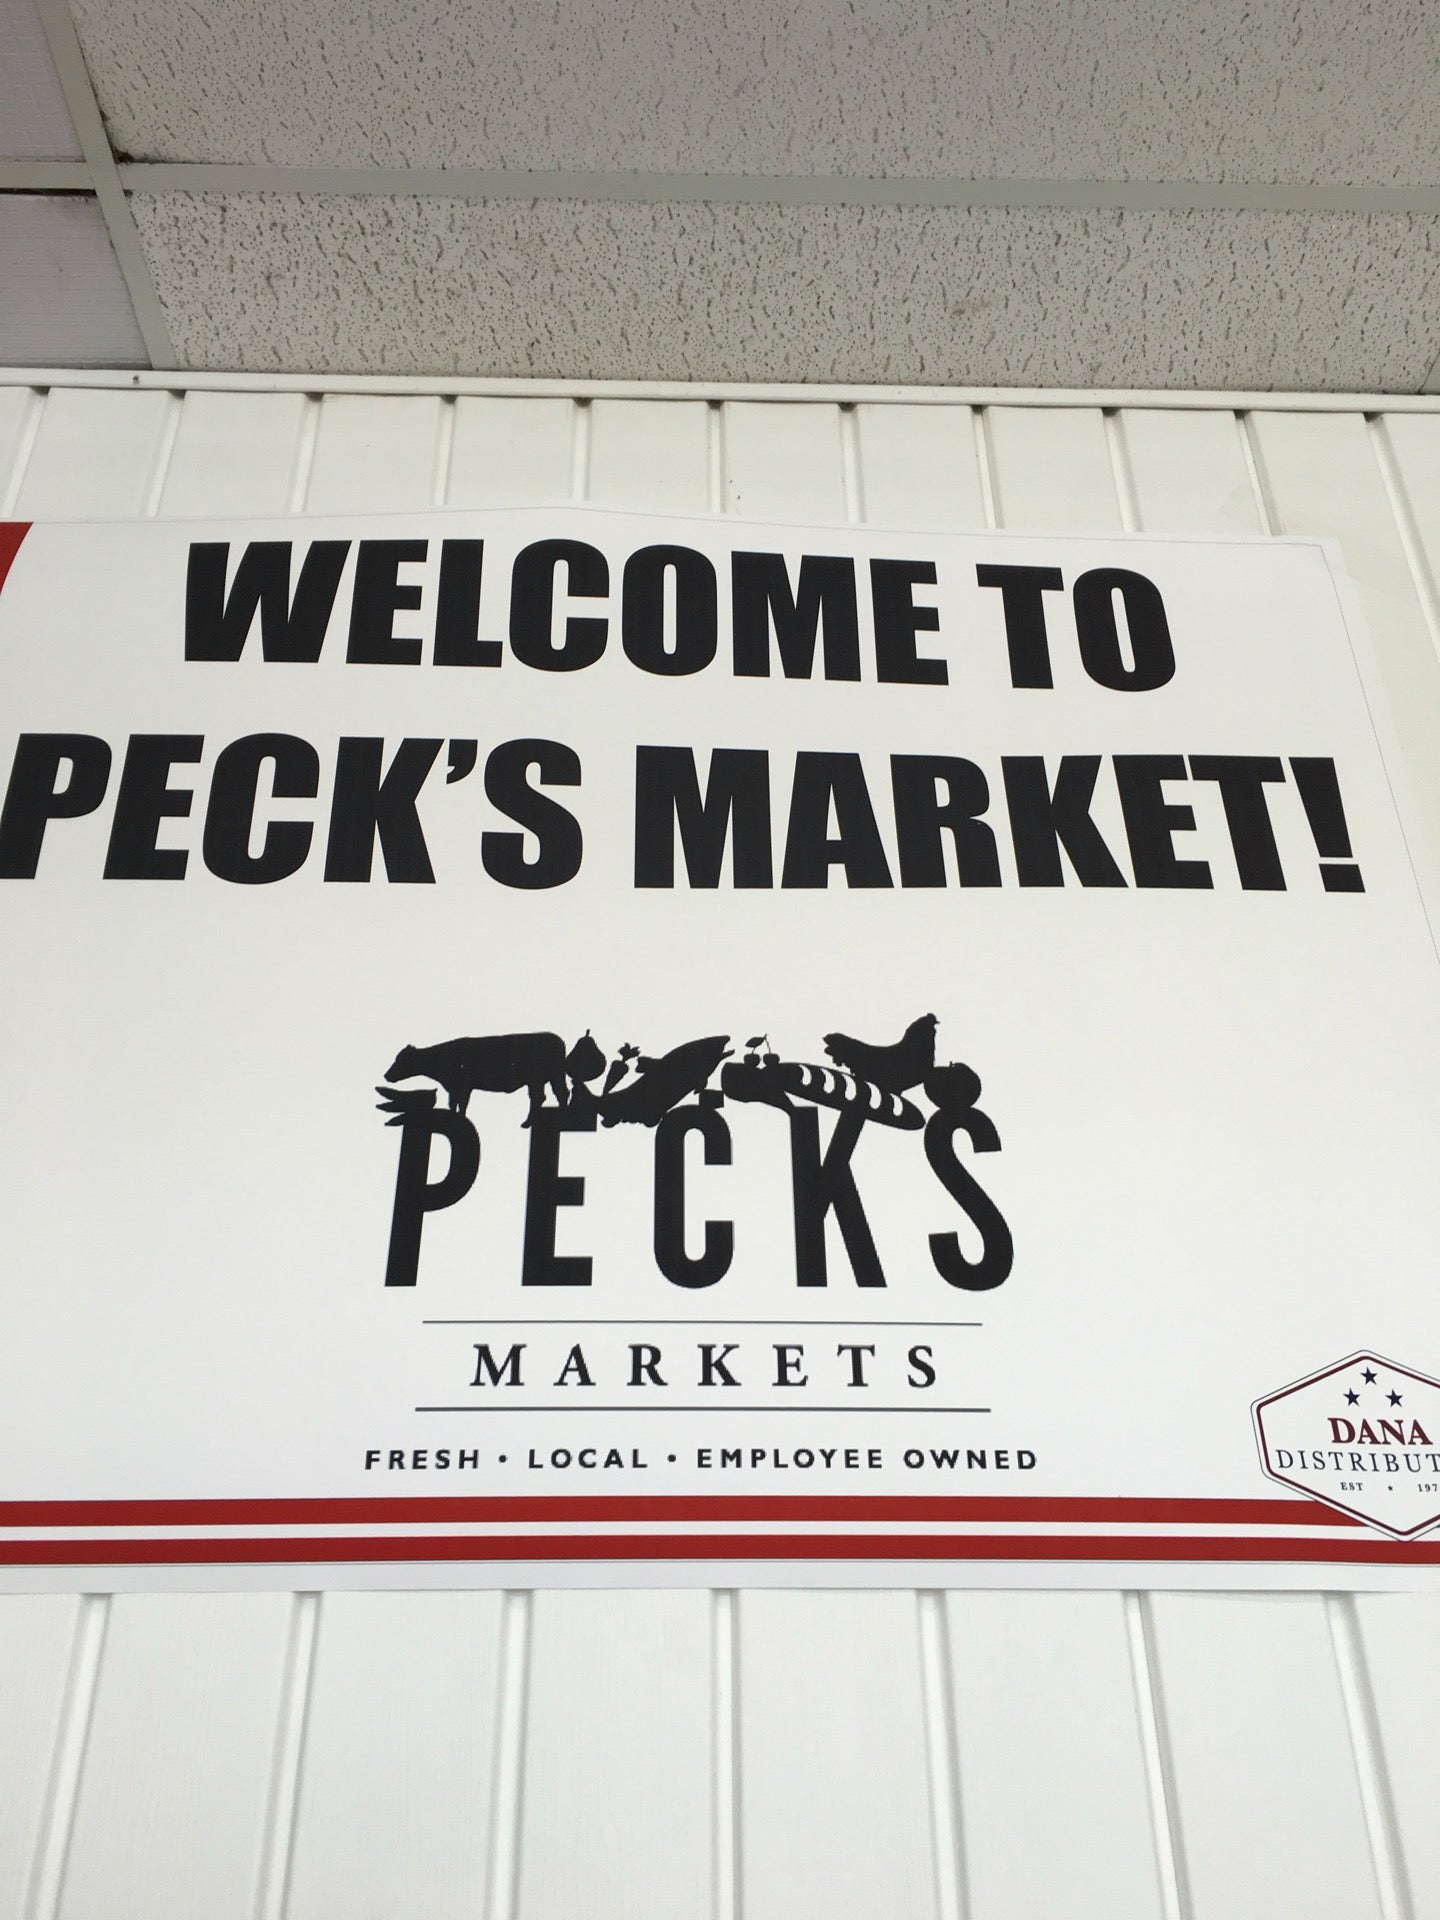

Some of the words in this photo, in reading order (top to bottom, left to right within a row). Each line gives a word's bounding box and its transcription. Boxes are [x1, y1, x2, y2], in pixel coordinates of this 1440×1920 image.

[184, 538, 950, 686] WELCOME
[975, 563, 1176, 693] TO
[634, 744, 1367, 894] MARKET!
[384, 1103, 1015, 1292] PECKS
[469, 1343, 938, 1389] MARKETS
[1327, 1417, 1434, 1446] DANA
[364, 1448, 479, 1471] FRESH
[528, 1448, 648, 1469] LOCAL
[697, 1448, 883, 1469] EMPLOYEE
[903, 1448, 1037, 1470] OWNED
[1340, 1481, 1364, 1492] EST
